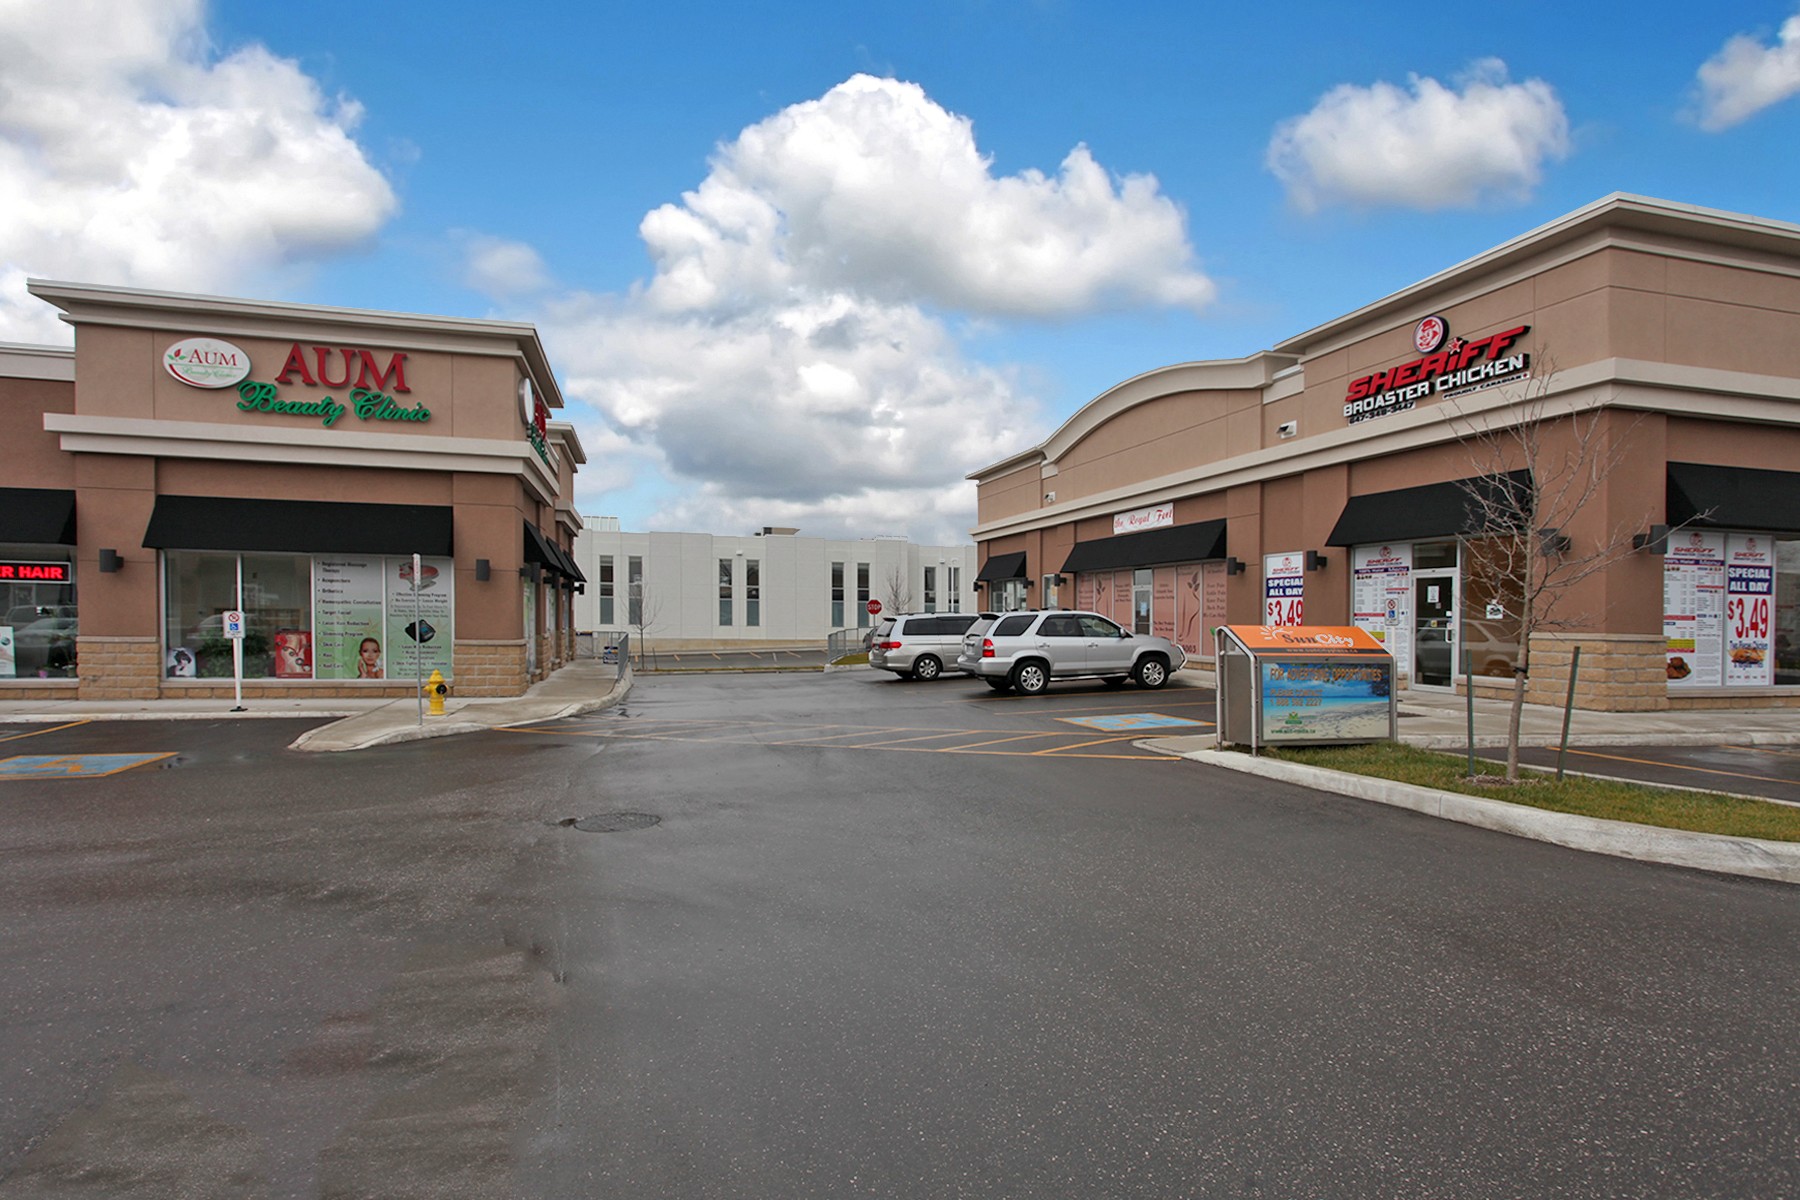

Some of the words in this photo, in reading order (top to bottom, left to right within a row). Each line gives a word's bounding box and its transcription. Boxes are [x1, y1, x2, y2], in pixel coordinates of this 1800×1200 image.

[188, 349, 237, 366] AUM
[275, 342, 411, 392] AUM
[1343, 380, 1433, 417] BROASTER
[1436, 353, 1530, 391] CHICKEN
[236, 381, 345, 427] Beauty
[349, 388, 431, 423] Clinic
[18, 566, 63, 579] HAIR
[1728, 567, 1771, 579] SPECIAL
[1269, 588, 1284, 596] ALL
[1285, 588, 1303, 596] DAY
[1729, 581, 1747, 591] ALL
[1749, 581, 1768, 592] DAY
[1267, 600, 1303, 626] $3.49
[1728, 597, 1768, 638] $3.49
[1270, 668, 1284, 681] FOR
[1287, 668, 1330, 681] ADVERTISING
[1332, 668, 1383, 682] OPPORTUNITIES
[1270, 688, 1294, 697] PLEASE
[1295, 688, 1323, 697] CONTACT
